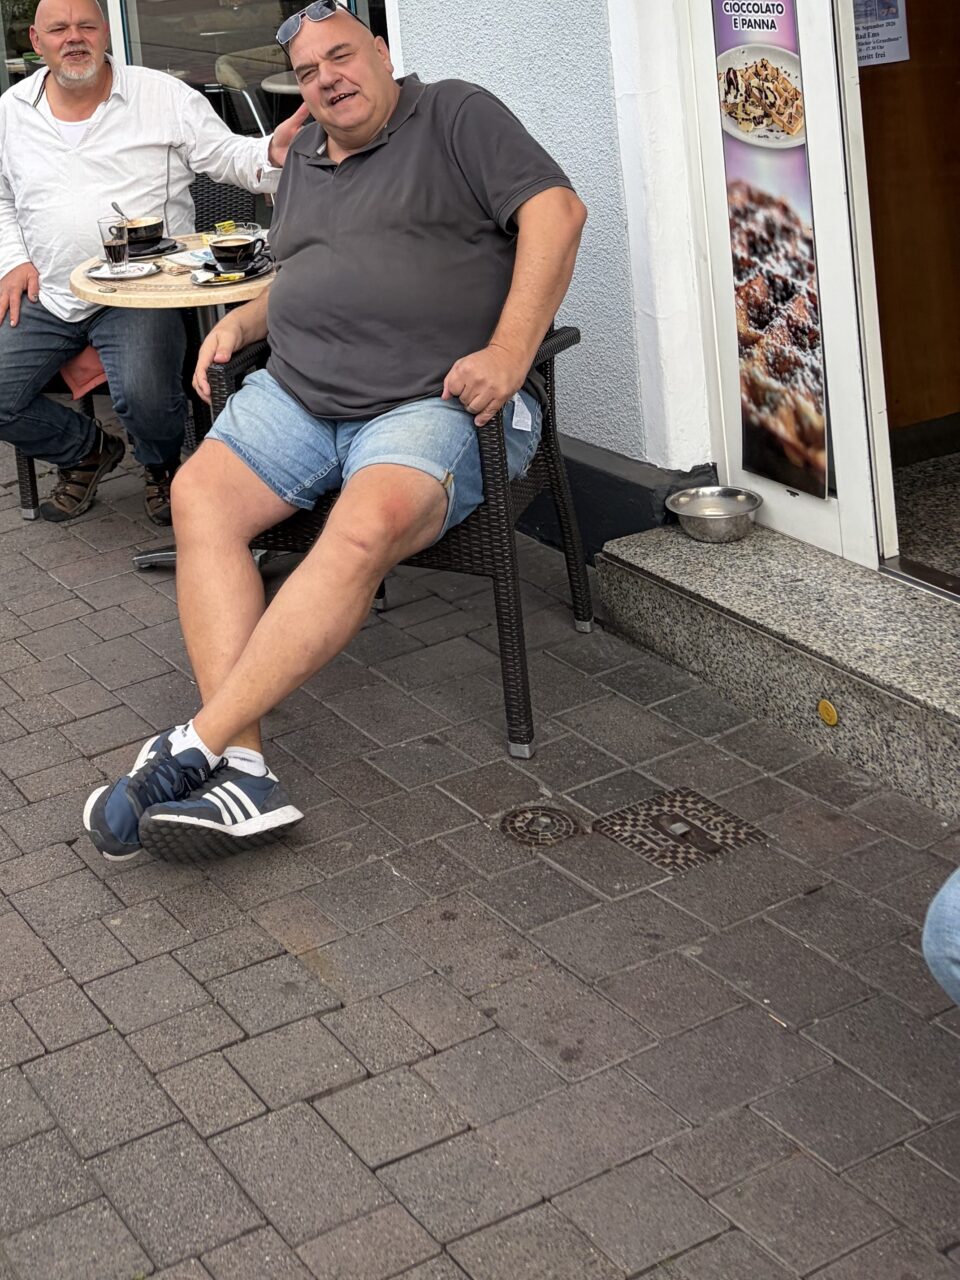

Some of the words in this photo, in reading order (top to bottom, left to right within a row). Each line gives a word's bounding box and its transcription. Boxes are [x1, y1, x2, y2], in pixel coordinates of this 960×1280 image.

[723, 2, 785, 15] CIOCCOLATO
[733, 18, 739, 29] E
[741, 18, 777, 30] PANNA
[683, 807, 726, 833] GAS
